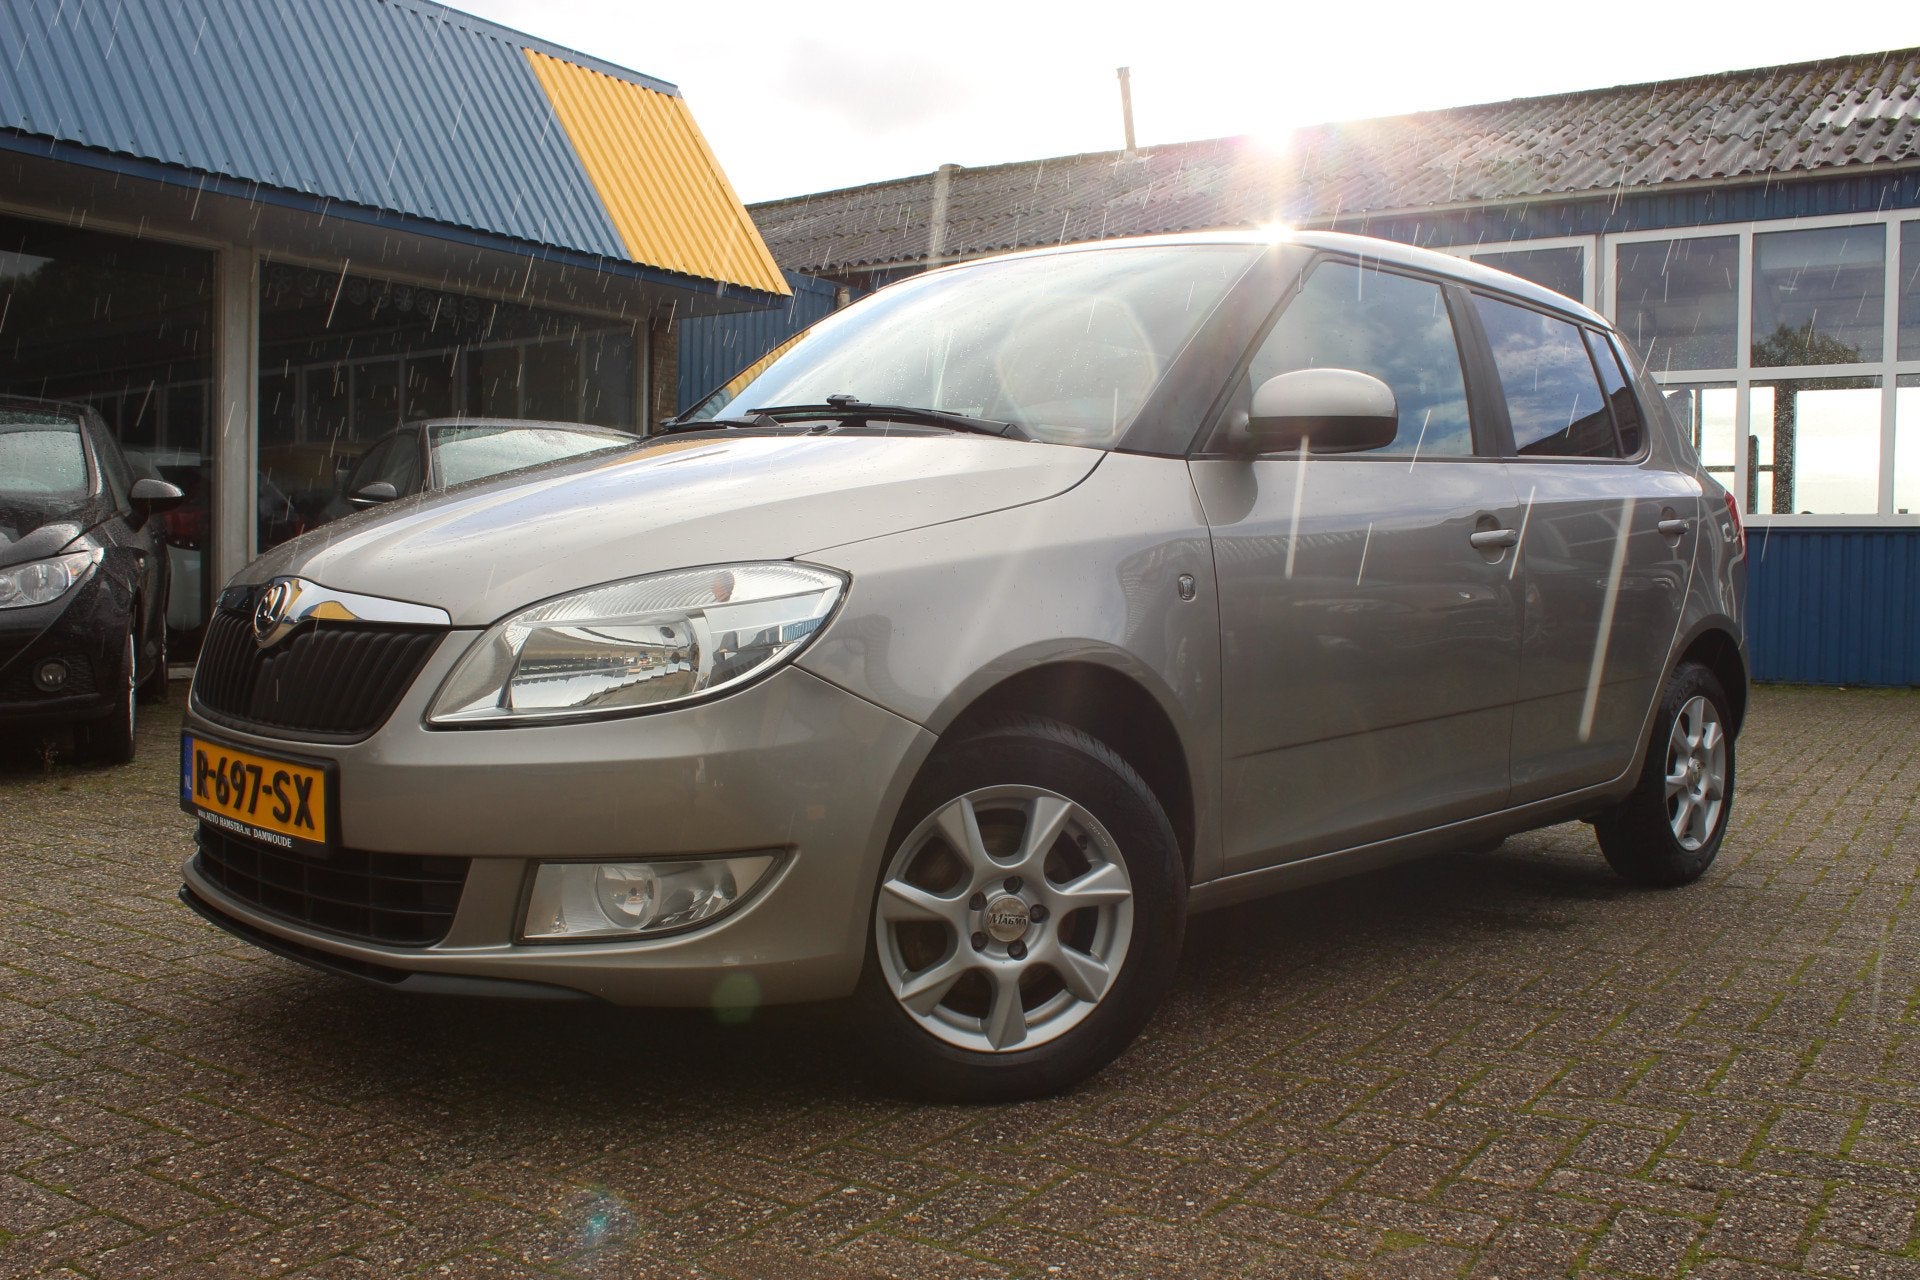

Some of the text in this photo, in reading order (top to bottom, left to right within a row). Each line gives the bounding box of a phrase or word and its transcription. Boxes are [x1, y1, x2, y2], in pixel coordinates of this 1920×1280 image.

[184, 774, 192, 790] NL
[196, 749, 315, 830] R-697-SX
[253, 828, 293, 848] DAMWOUDE
